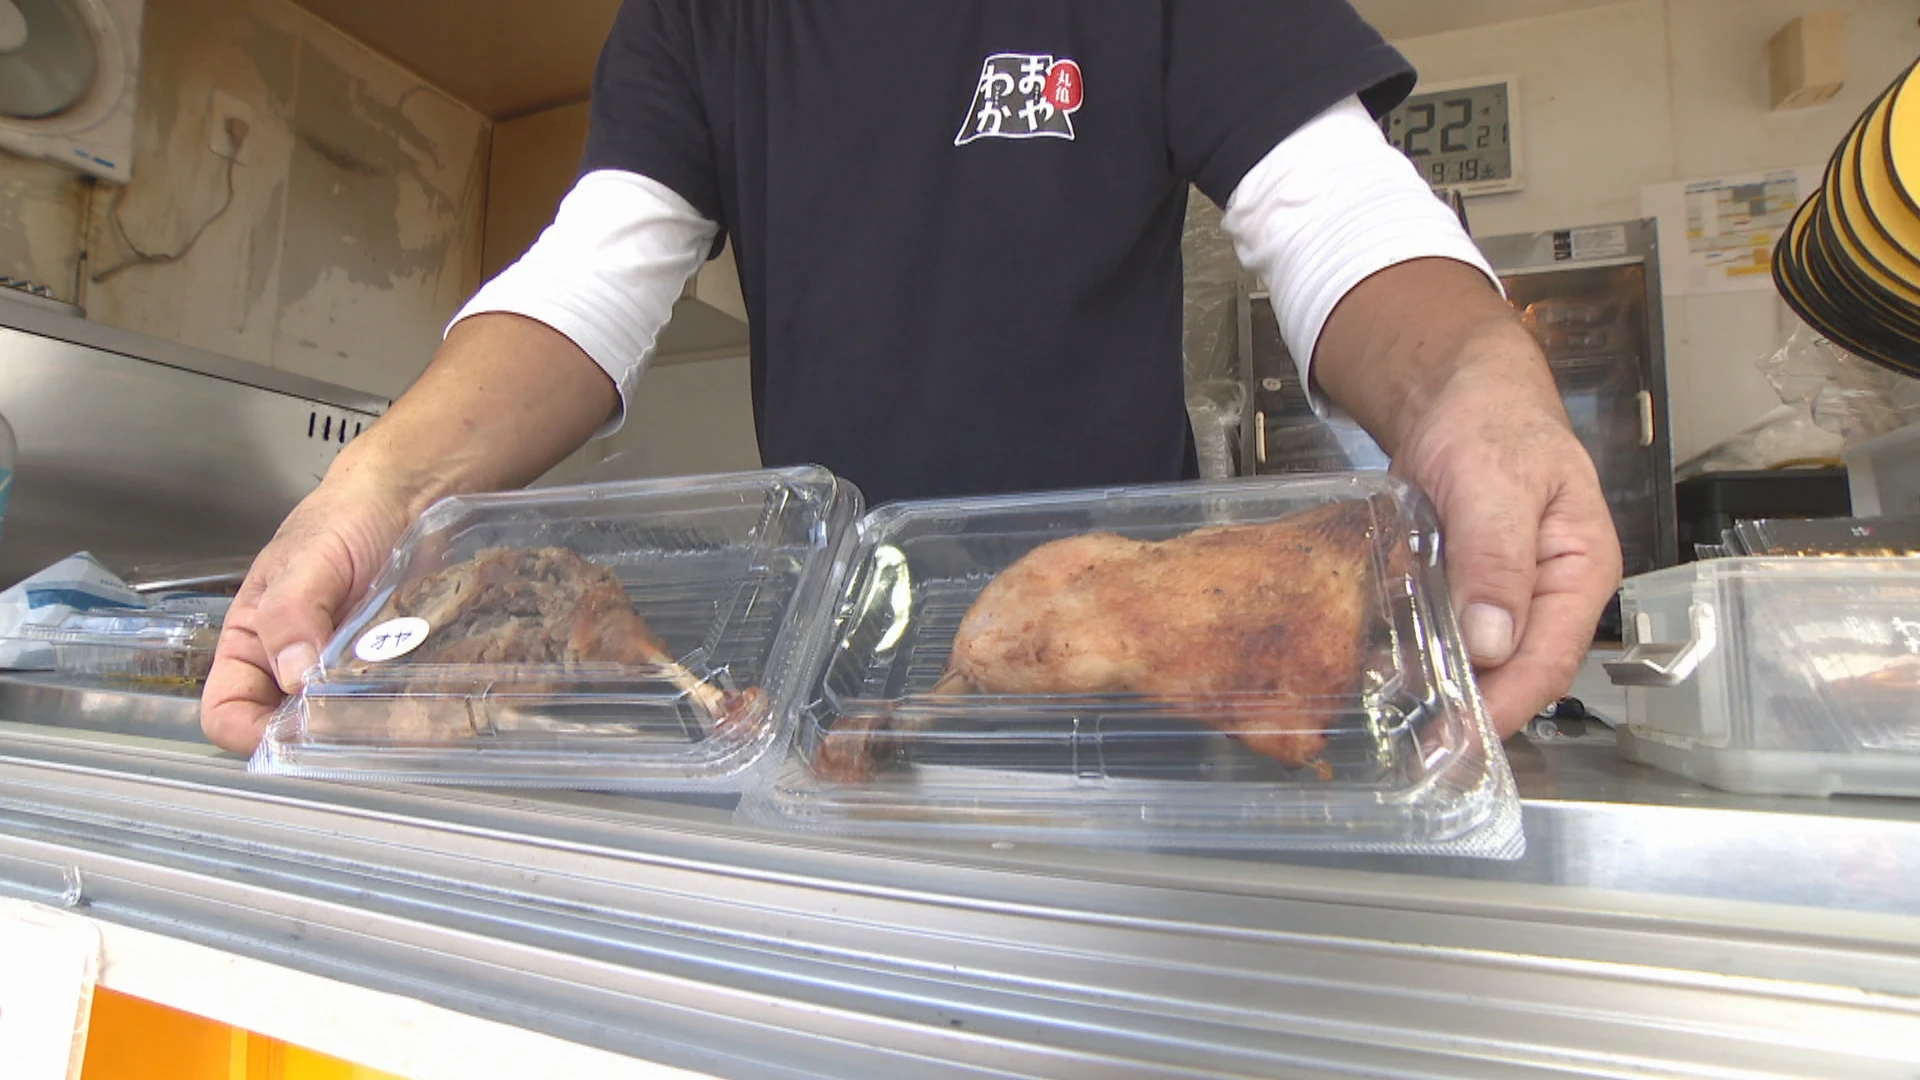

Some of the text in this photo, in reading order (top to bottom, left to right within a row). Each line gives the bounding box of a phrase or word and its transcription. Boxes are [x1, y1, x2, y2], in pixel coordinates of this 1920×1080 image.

[976, 63, 1014, 134] わか
[1018, 56, 1055, 131] おや
[1477, 121, 1508, 149] 21
[370, 631, 412, 650] オヤ
